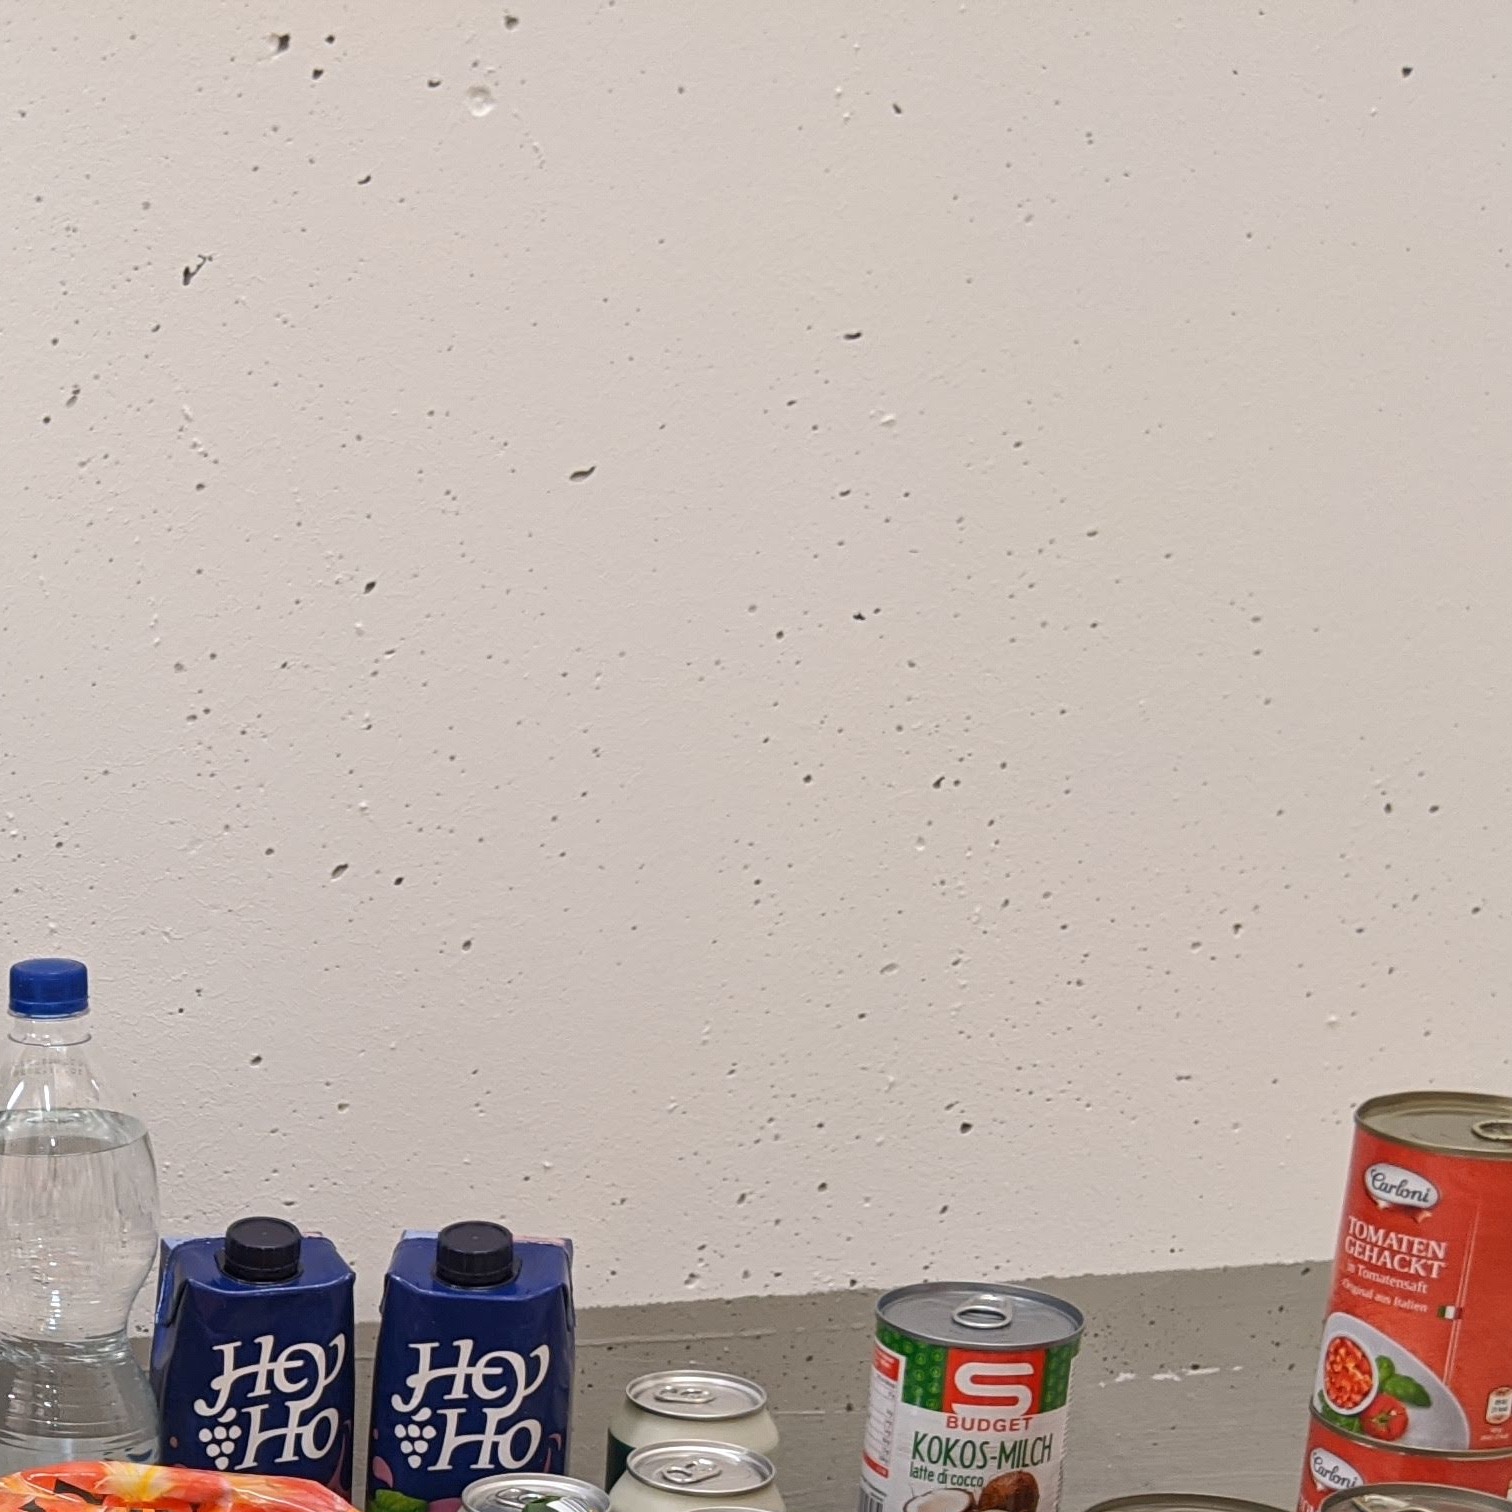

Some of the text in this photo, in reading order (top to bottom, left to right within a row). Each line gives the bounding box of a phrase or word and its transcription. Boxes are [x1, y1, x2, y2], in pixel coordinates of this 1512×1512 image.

[1371, 1169, 1430, 1202] Carloni
[1345, 1236, 1447, 1278] GEHACKT
[1348, 1216, 1448, 1259] TOMATEN
[1356, 1265, 1428, 1294] Tomatensaft
[194, 1334, 345, 1417] Hey
[391, 1339, 549, 1417] Hey
[234, 1403, 339, 1471] Ho
[427, 1407, 542, 1471] Ho
[946, 1415, 1034, 1432] BUDGET
[911, 1430, 1053, 1470] KOKOS-MILCH
[1313, 1452, 1358, 1488] Carloni
[910, 1464, 984, 1488] latte di cocco
